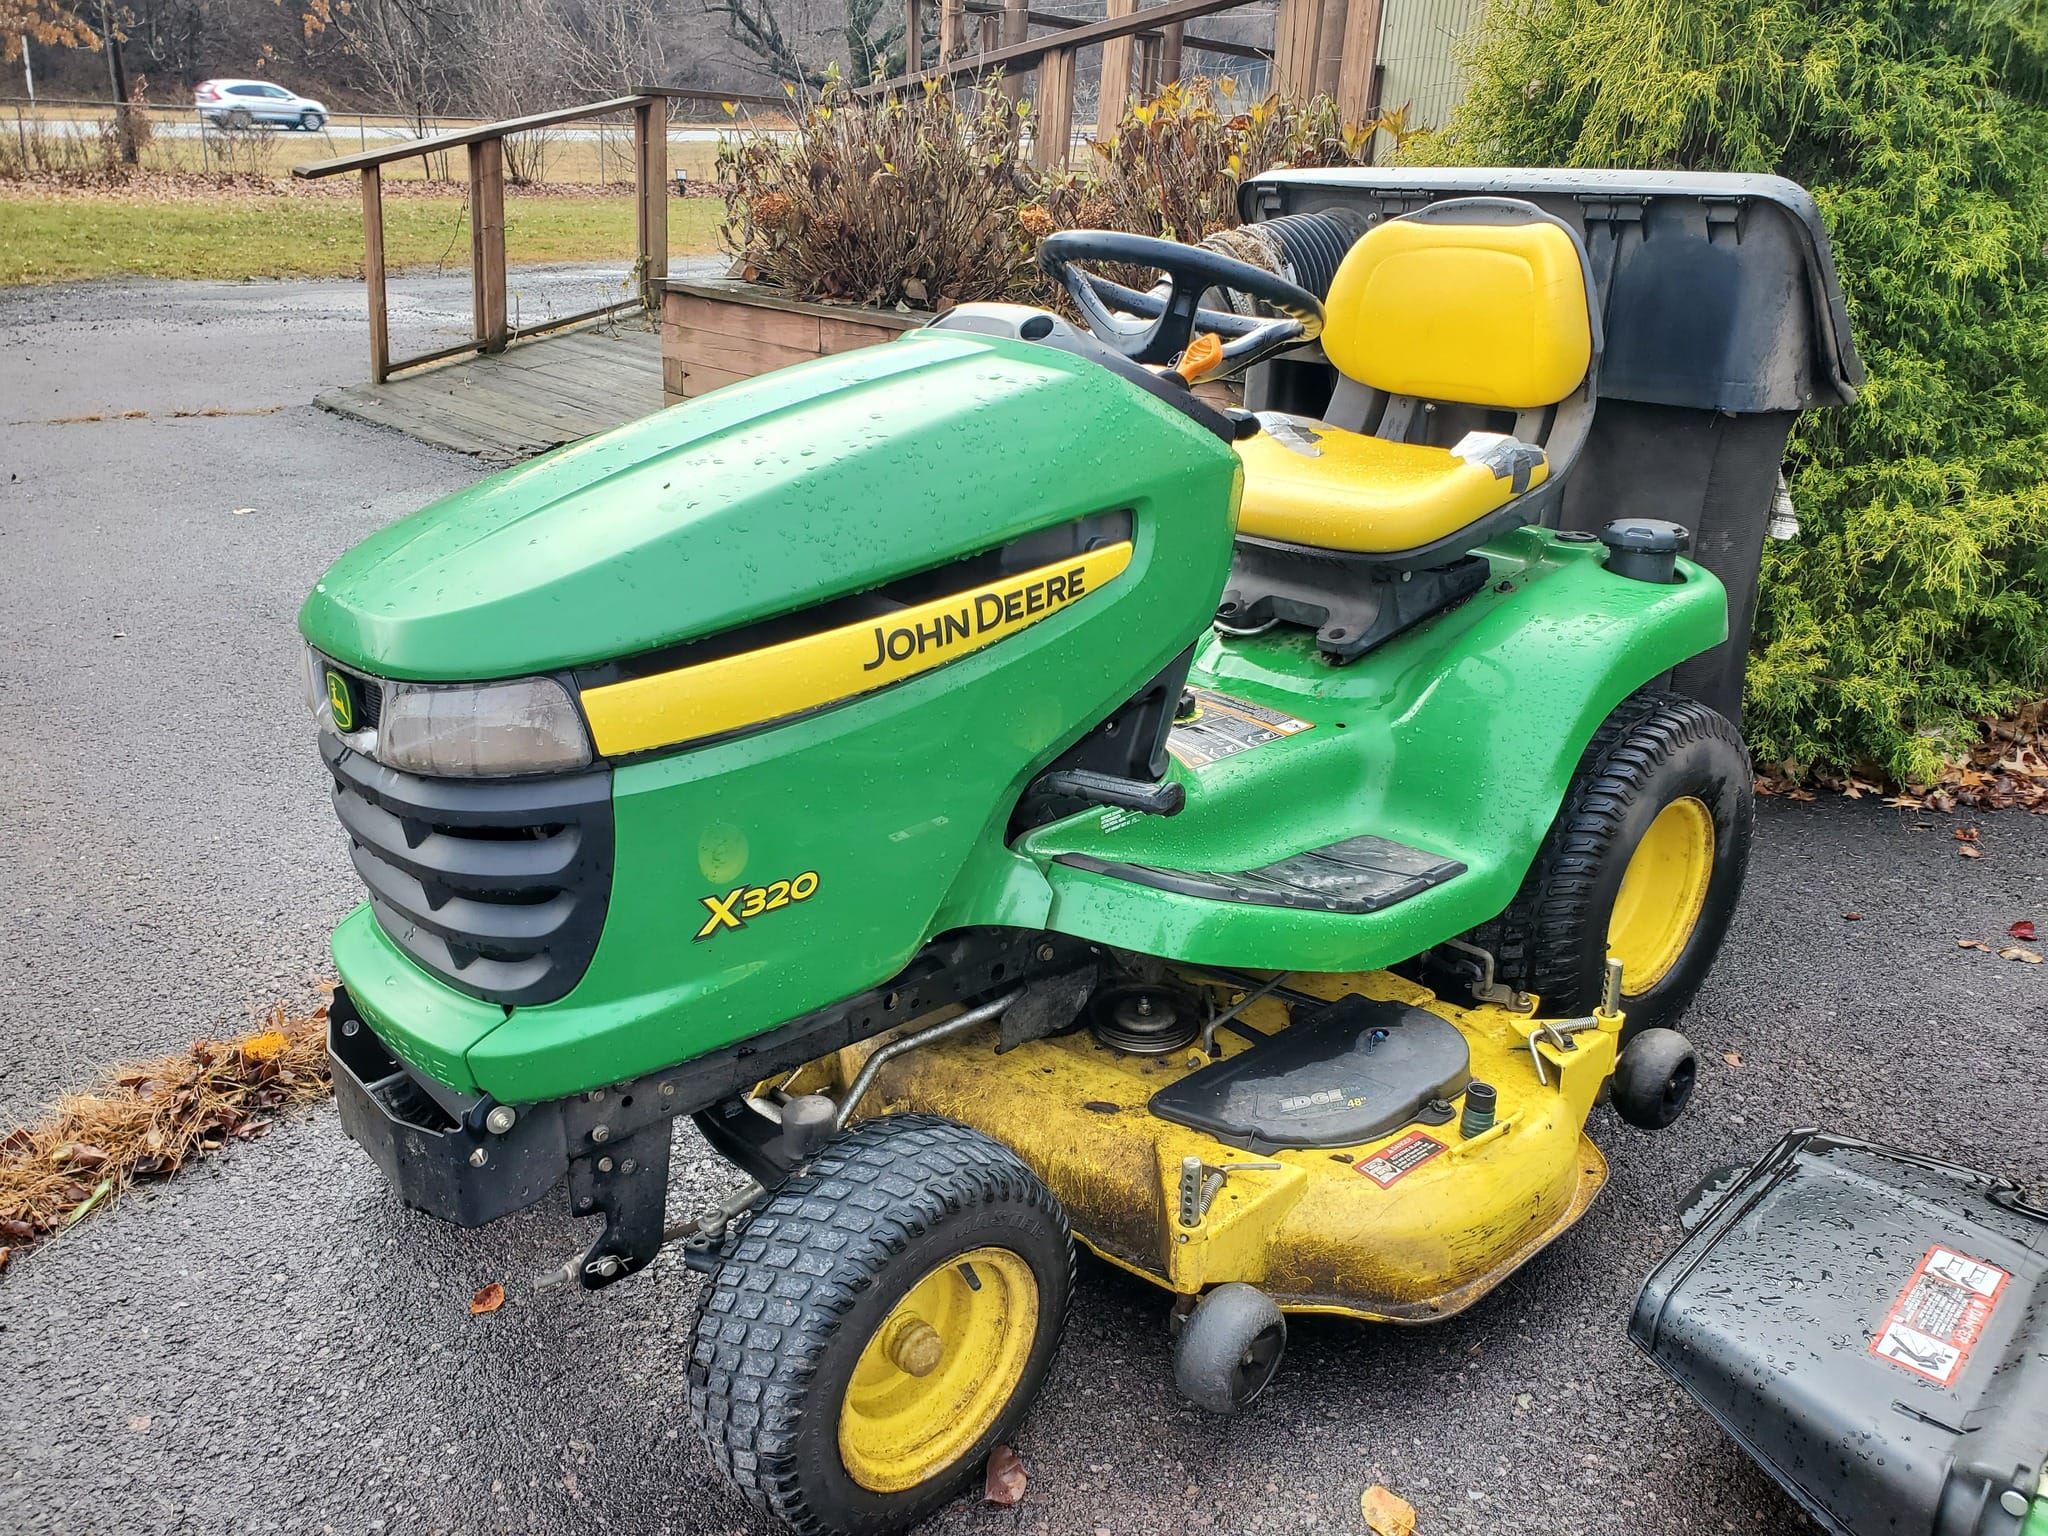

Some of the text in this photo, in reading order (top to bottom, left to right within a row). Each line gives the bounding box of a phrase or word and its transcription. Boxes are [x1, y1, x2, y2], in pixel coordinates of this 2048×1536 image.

[863, 567, 1086, 671] JOHN DEERE
[691, 870, 820, 941] X320
[1955, 1307, 1984, 1344] DANGER
